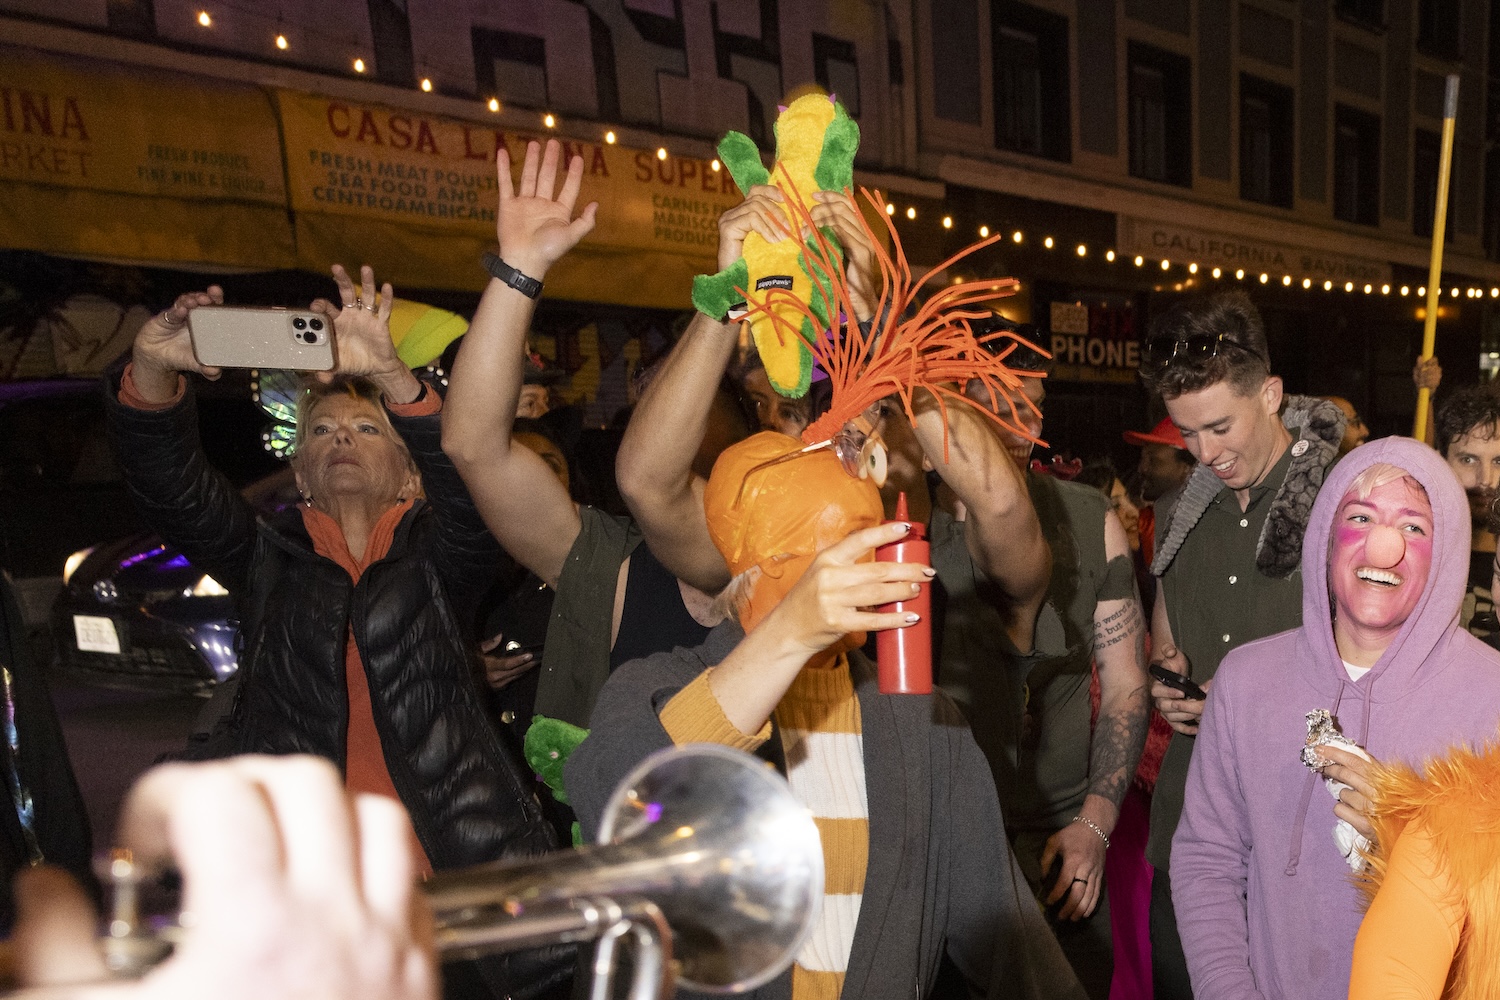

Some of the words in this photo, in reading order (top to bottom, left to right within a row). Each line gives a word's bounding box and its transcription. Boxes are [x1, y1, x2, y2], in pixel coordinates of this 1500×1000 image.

[327, 102, 440, 155] CASA
[462, 126, 610, 179] LANA
[308, 149, 372, 174] FRESH
[377, 161, 429, 182] MEAT
[435, 168, 498, 191] POULT
[328, 171, 366, 190] SEA
[370, 177, 428, 199] FOOD
[436, 186, 479, 204] AND
[652, 192, 710, 216] CARNES
[1152, 230, 1287, 270] CALIFORNIA
[1051, 335, 1140, 368] PHONE
[1105, 621, 1124, 636] but
